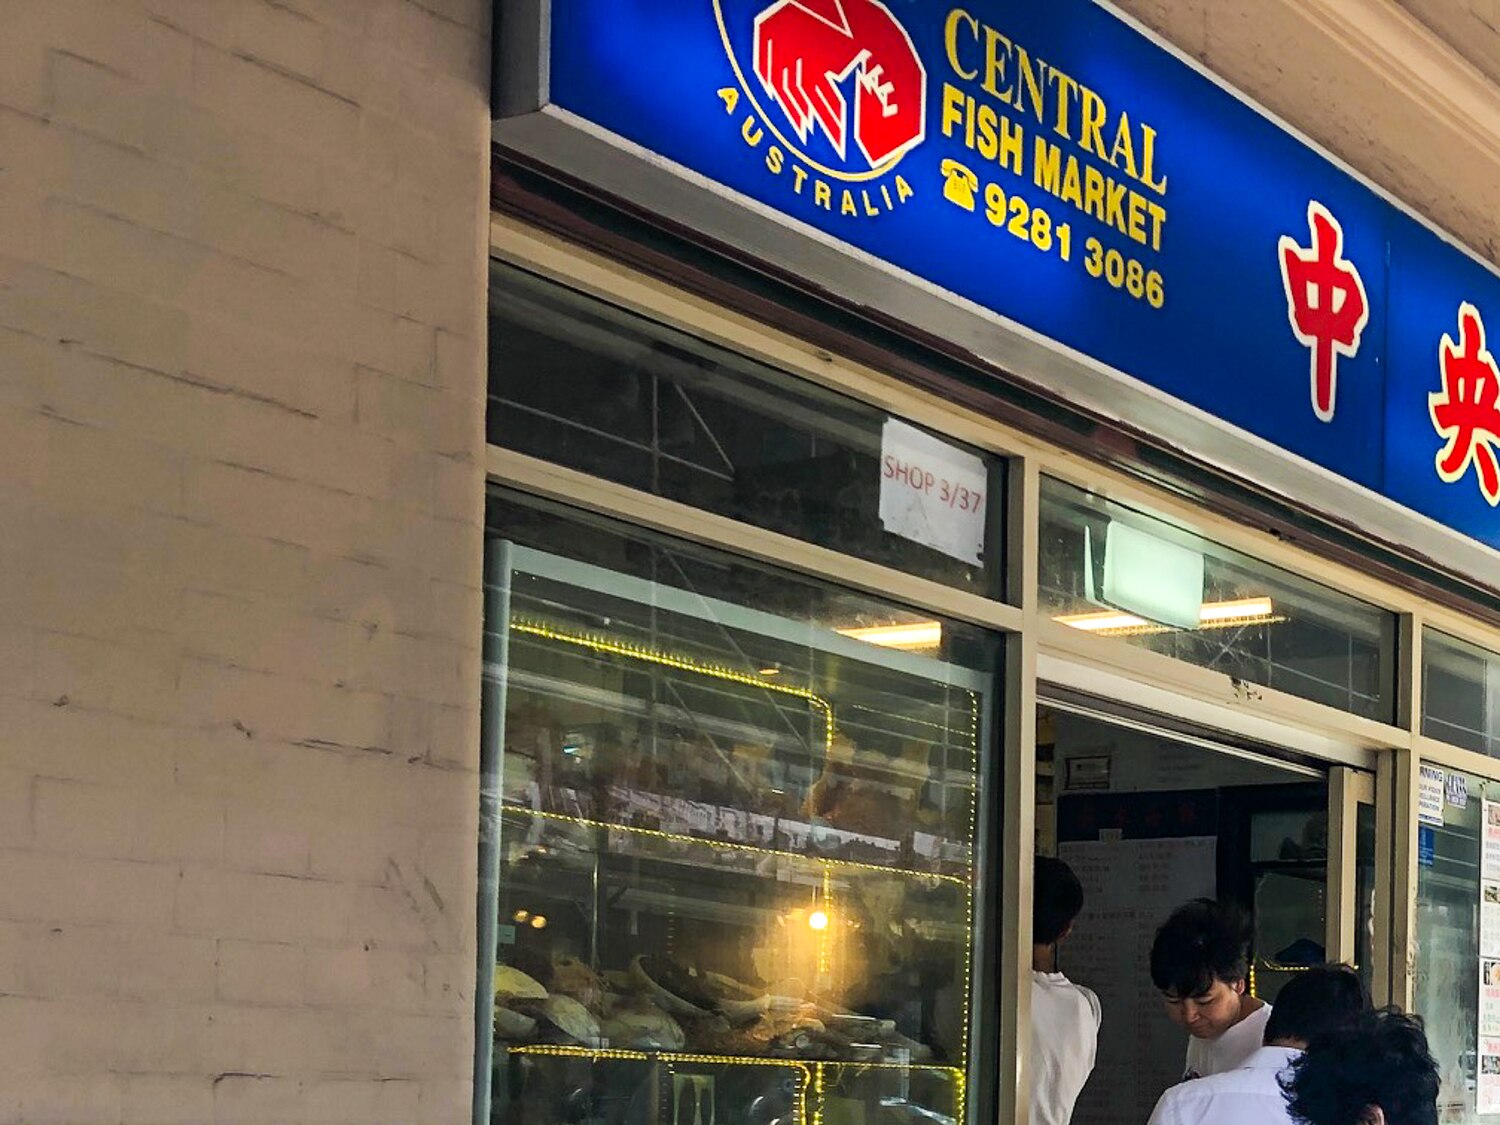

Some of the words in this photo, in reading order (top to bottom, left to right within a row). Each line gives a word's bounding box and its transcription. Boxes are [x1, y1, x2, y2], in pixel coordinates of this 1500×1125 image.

[716, 86, 914, 217] AUSTRALIA
[942, 82, 1024, 176] FISH
[1034, 135, 1167, 252] MARKET
[943, 8, 1168, 195] CENTRAL
[985, 183, 1071, 262] 9281
[1084, 237, 1165, 309] 3086
[883, 455, 935, 496] SHOP
[940, 478, 982, 514] 3/37
